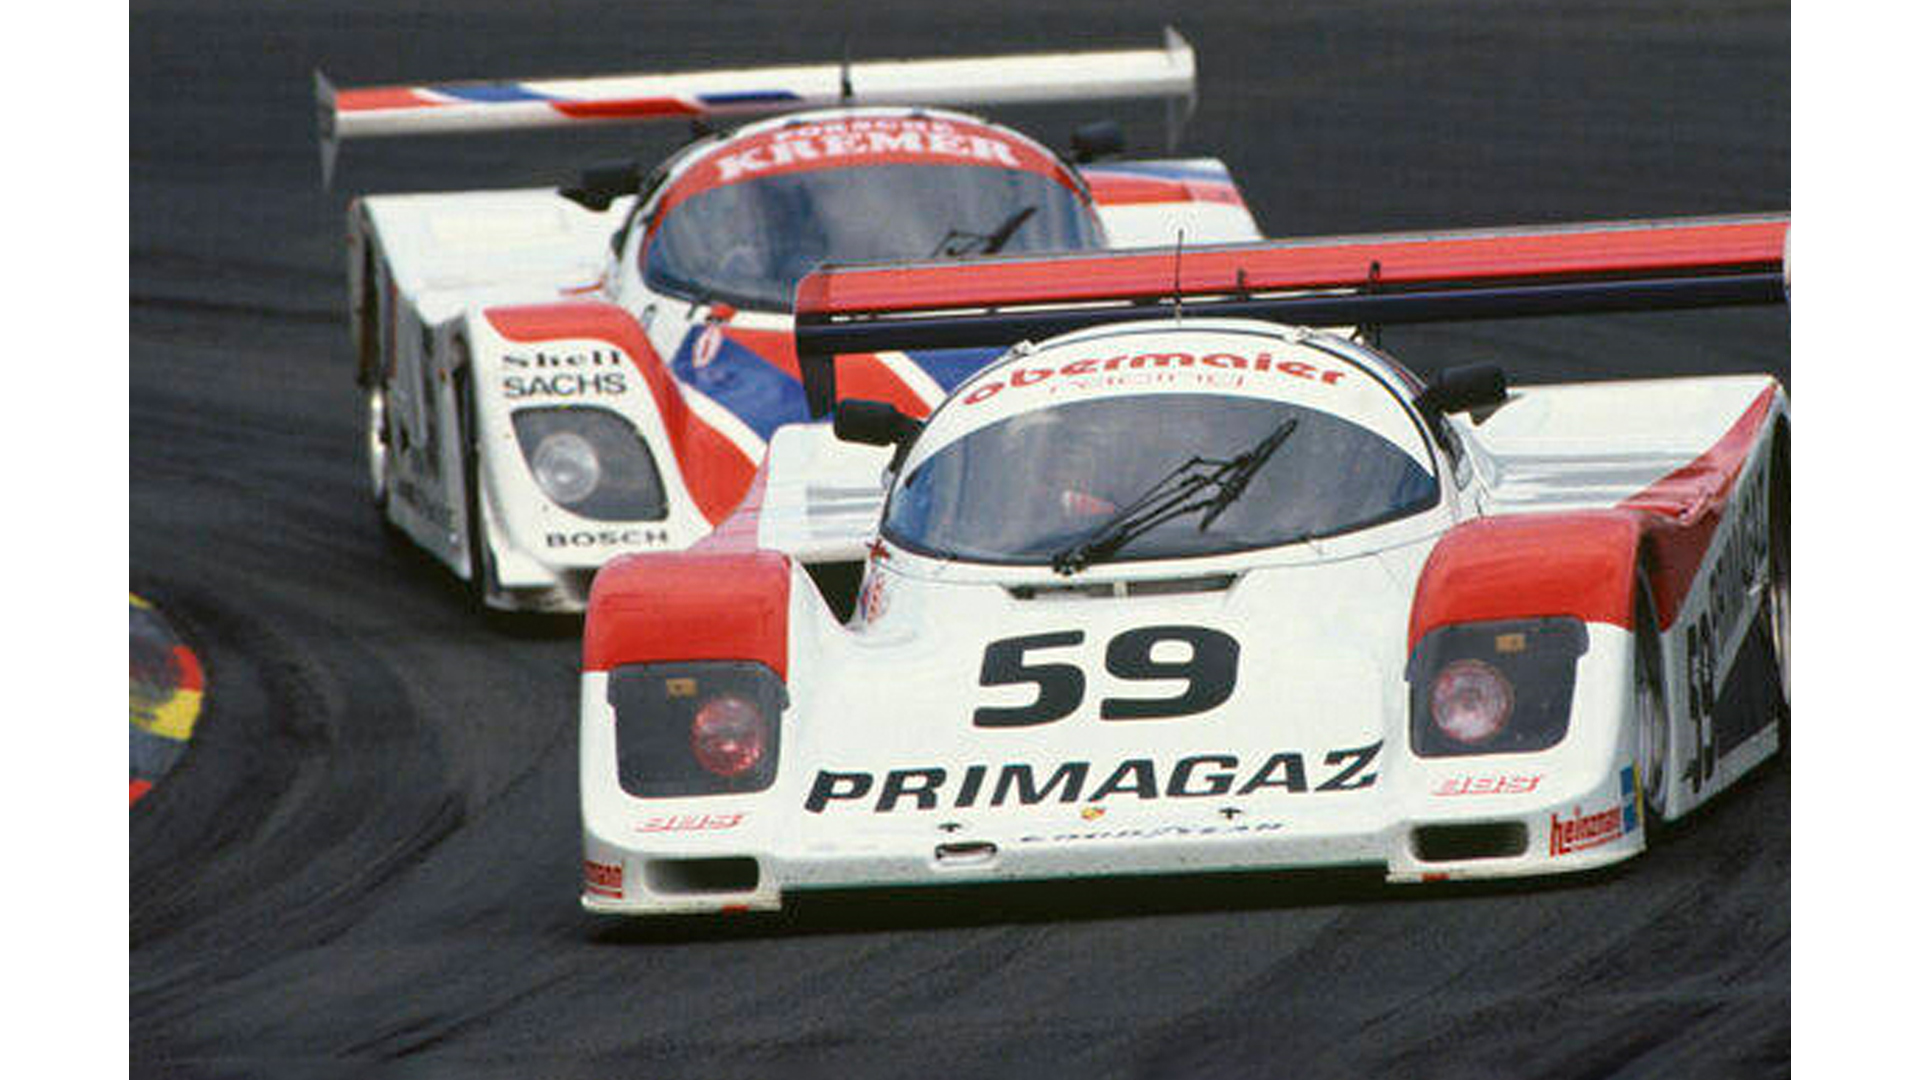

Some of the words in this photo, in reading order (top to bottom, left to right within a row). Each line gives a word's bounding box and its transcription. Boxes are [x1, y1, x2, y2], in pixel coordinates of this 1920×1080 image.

[714, 130, 1020, 181] KREMER
[502, 349, 622, 368] Shell
[963, 352, 1347, 405] obermaier
[503, 373, 627, 398] SACHS
[545, 530, 669, 548] BOSCH
[973, 625, 1241, 728] 59
[804, 739, 1384, 814] PRIMAGAZ
